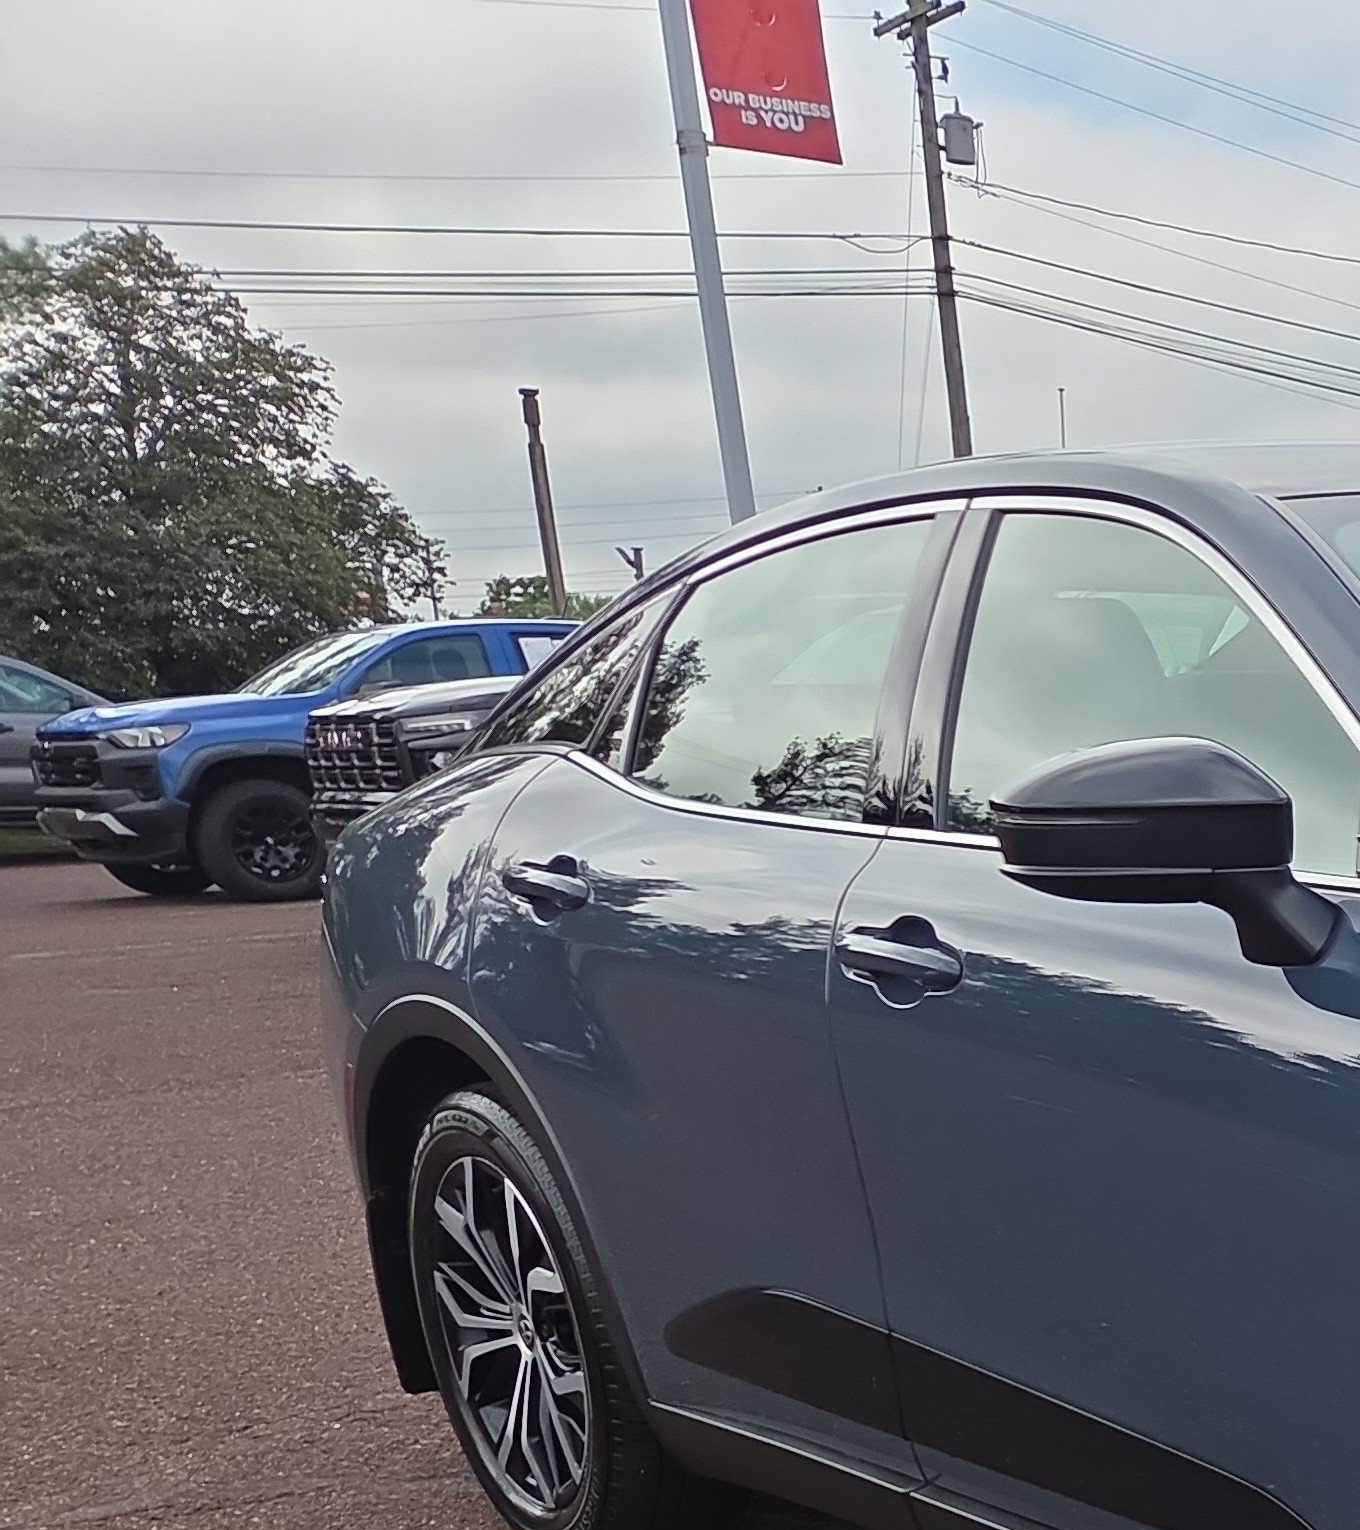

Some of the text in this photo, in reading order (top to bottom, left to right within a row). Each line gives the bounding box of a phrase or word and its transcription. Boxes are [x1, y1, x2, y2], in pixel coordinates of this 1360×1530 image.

[708, 87, 831, 119] OUR BUSINESS
[740, 108, 805, 133] IS YOU
